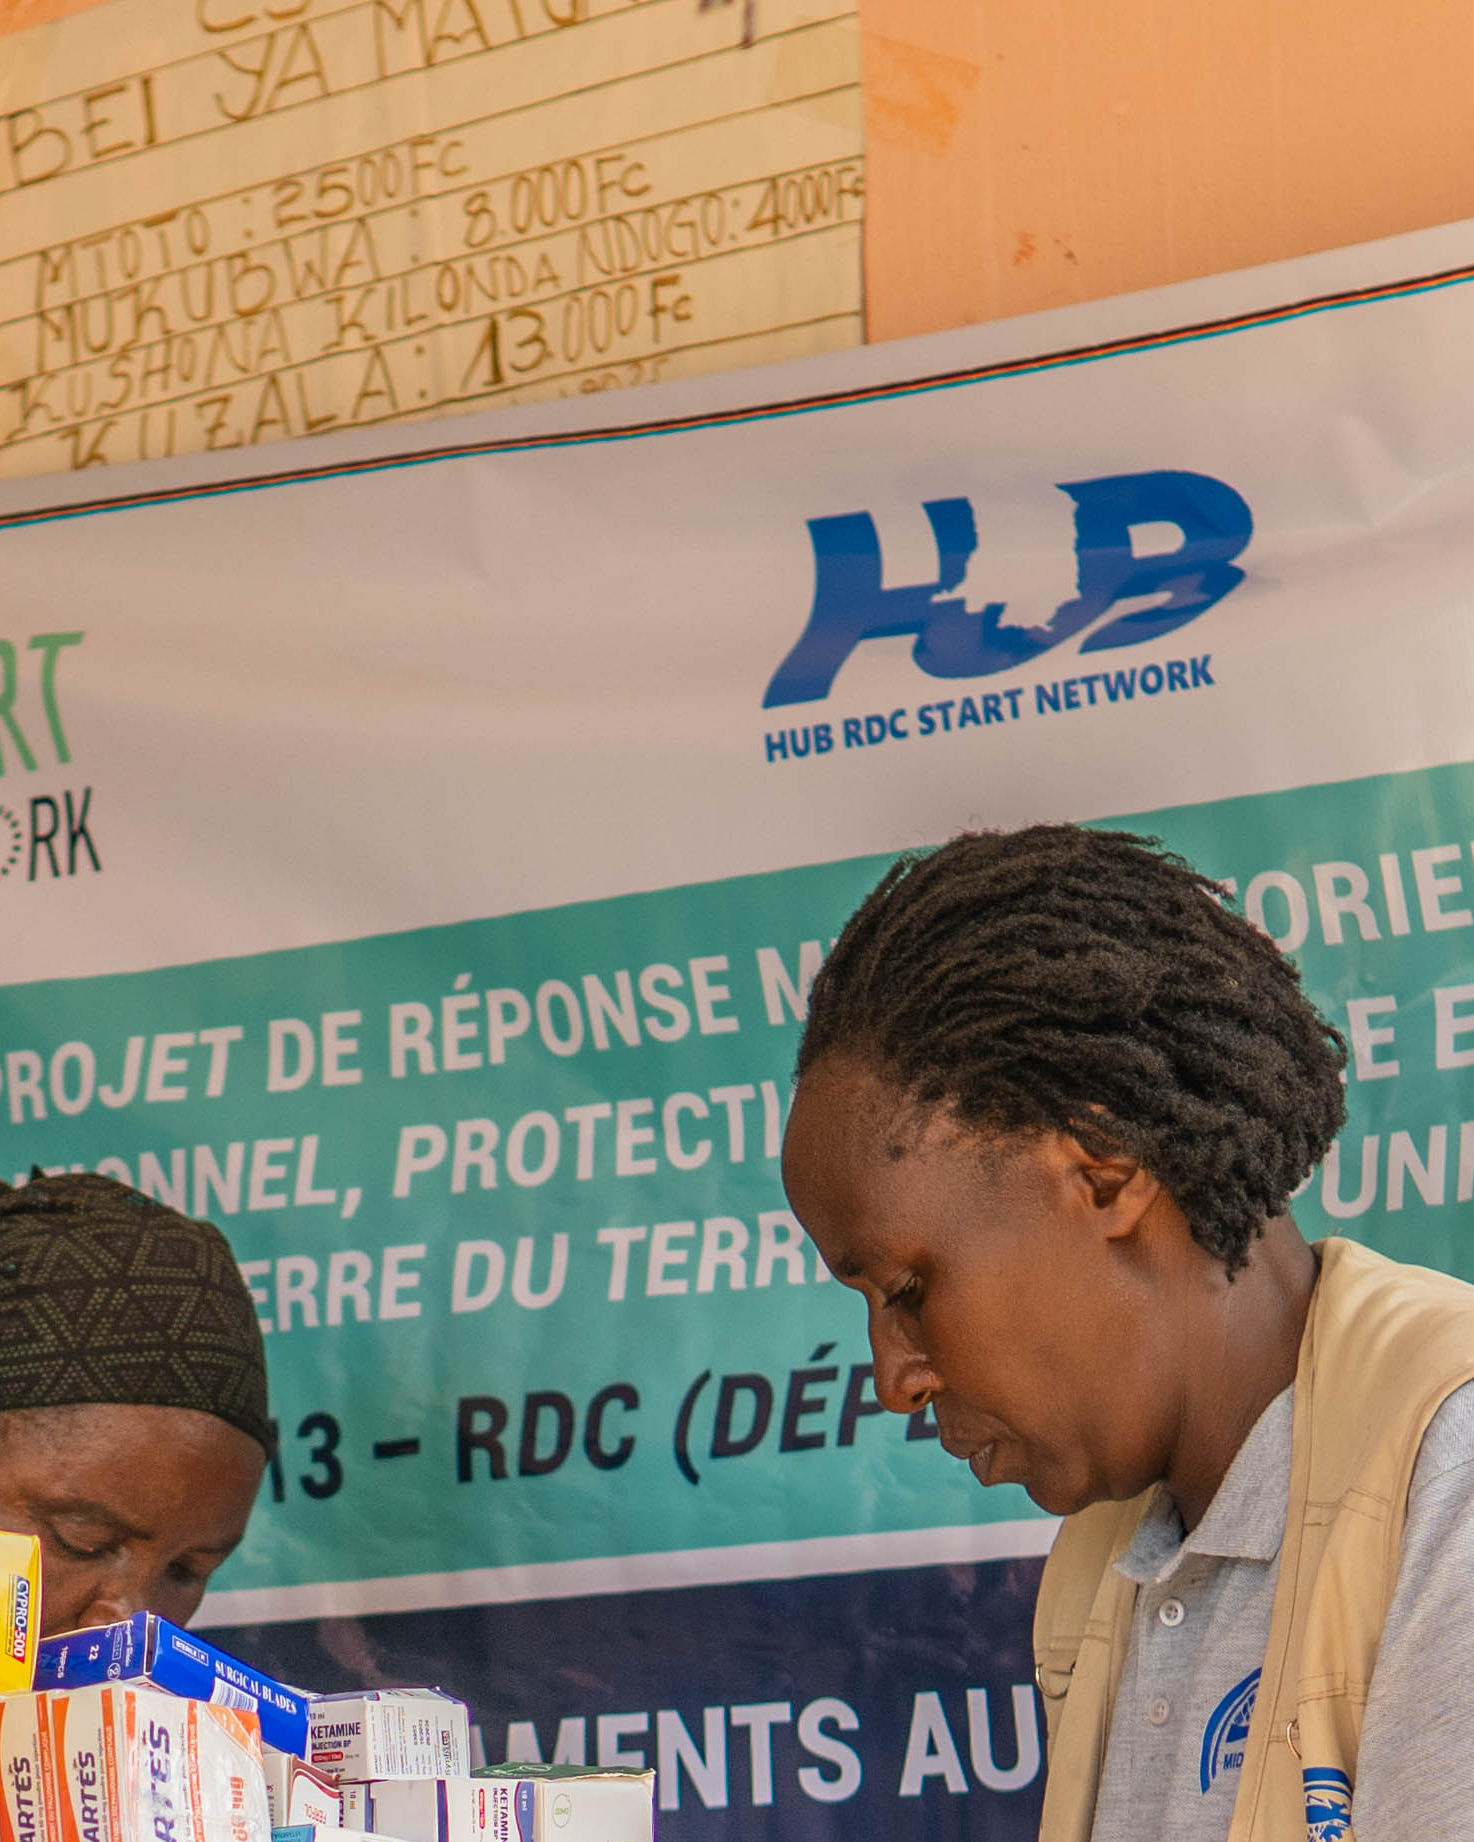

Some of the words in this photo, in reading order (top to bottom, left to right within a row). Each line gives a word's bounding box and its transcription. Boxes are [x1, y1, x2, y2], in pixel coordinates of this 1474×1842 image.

[6, 74, 160, 188] BEI
[213, 22, 329, 122] YA
[63, 345, 399, 471] KUZALA
[762, 469, 1253, 709] HUB
[765, 723, 833, 762] HUB
[844, 708, 909, 750] RDC
[919, 687, 1024, 735] START
[1035, 654, 1215, 716] NETWORK
[265, 1009, 362, 1094] DE
[389, 954, 741, 1078] RÉPONSE
[393, 1080, 792, 1198] PROTECTI
[451, 1232, 569, 1314] DU
[597, 1208, 832, 1302] TERR
[457, 1382, 641, 1484] RDC
[12, 1580, 30, 1659] CYPRO-500
[215, 1659, 261, 1697] SURGICAL
[262, 1687, 298, 1716] BLADES
[310, 1722, 361, 1739] KETAMINE
